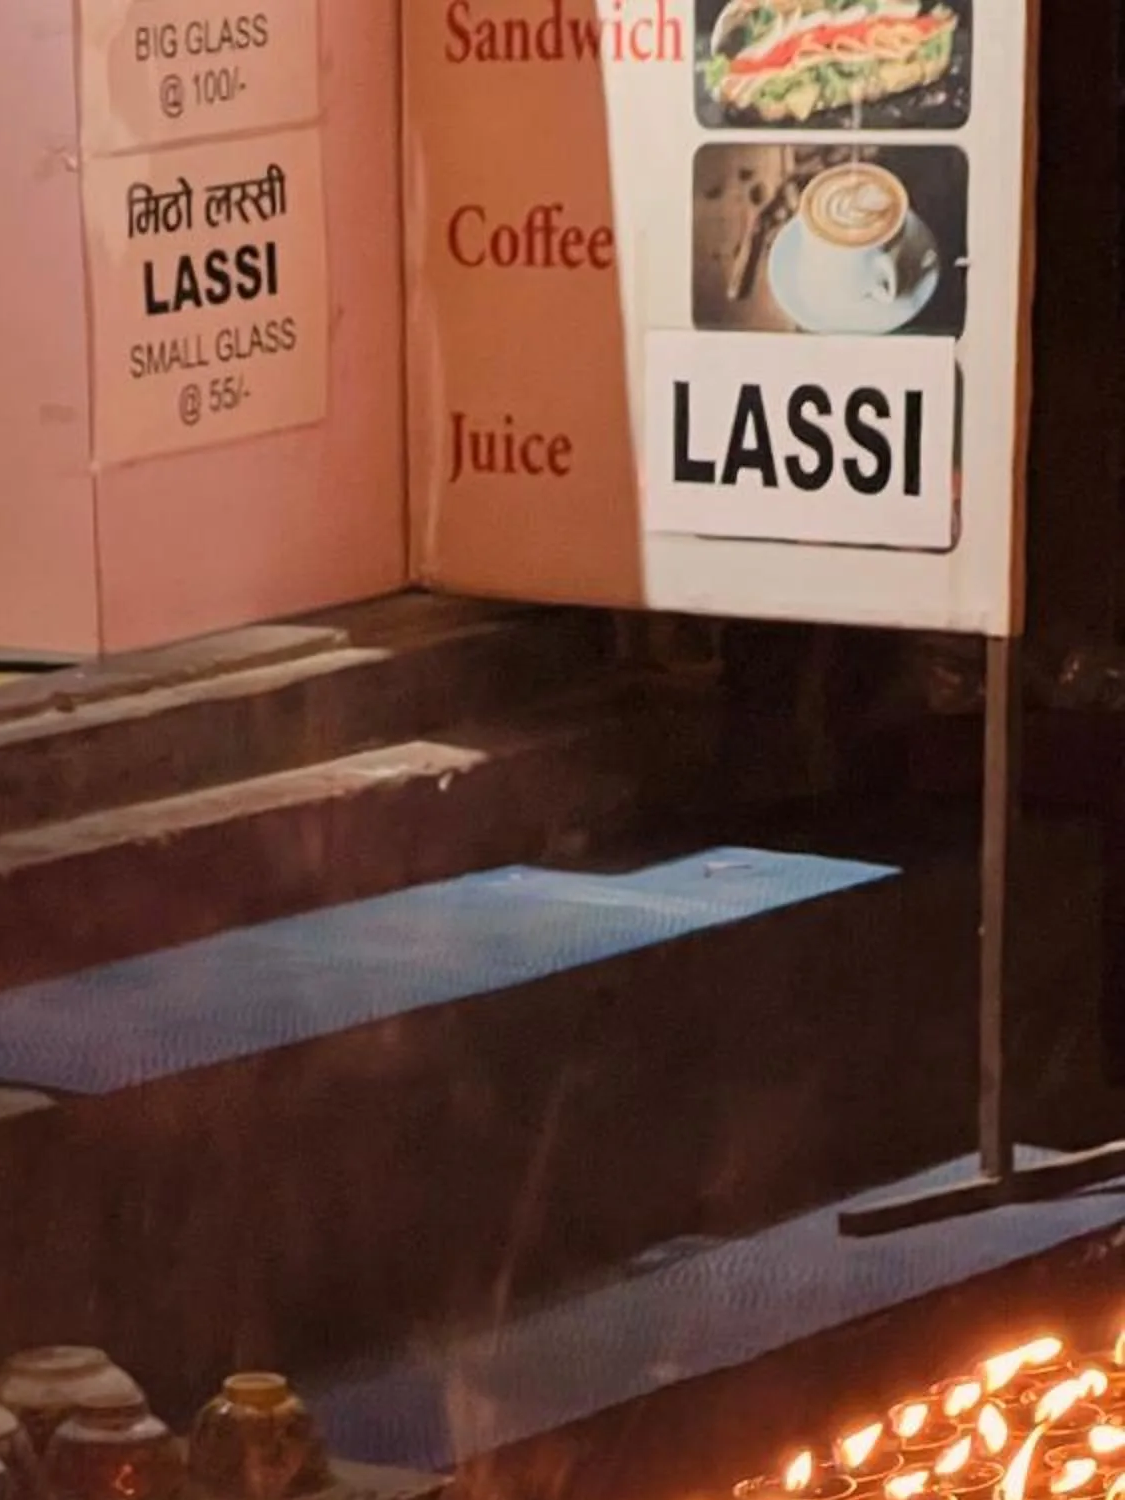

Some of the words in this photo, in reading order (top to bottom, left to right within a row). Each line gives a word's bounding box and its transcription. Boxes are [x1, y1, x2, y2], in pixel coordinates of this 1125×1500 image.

[135, 23, 177, 62] BIG
[185, 13, 268, 55] GLASS
[445, 0, 684, 63] Sandwich
[160, 73, 183, 119] @
[193, 66, 246, 104] 100/-
[128, 177, 193, 238] मिठो
[204, 163, 286, 228] लस्सी
[447, 203, 614, 270] Coffee
[143, 241, 277, 316] LASSI
[130, 333, 209, 378] SMALL
[215, 317, 296, 362] GLASS
[179, 383, 202, 426] @
[208, 373, 251, 412] 55/-
[449, 411, 573, 482] Juice
[672, 380, 923, 496] LASSI
